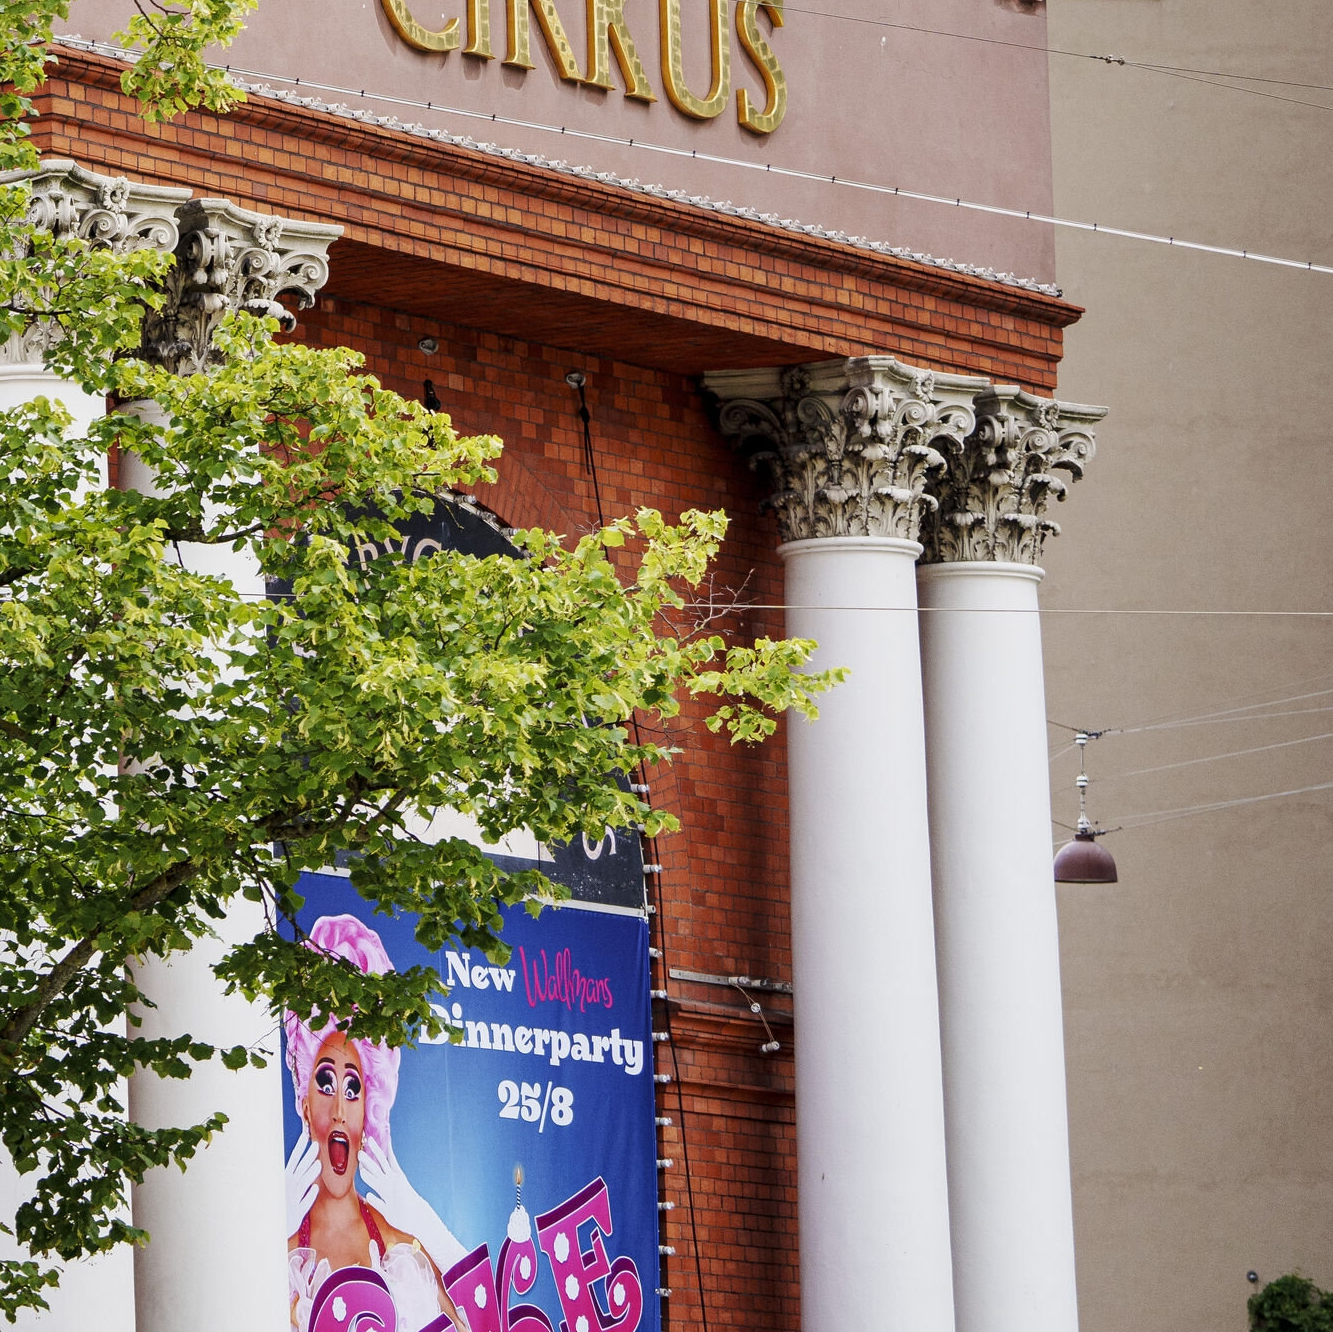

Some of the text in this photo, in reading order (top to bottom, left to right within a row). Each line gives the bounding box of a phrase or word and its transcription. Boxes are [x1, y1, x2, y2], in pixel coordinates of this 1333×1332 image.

[445, 945, 613, 1013] New Wallmans
[497, 1079, 574, 1134] 25/8
